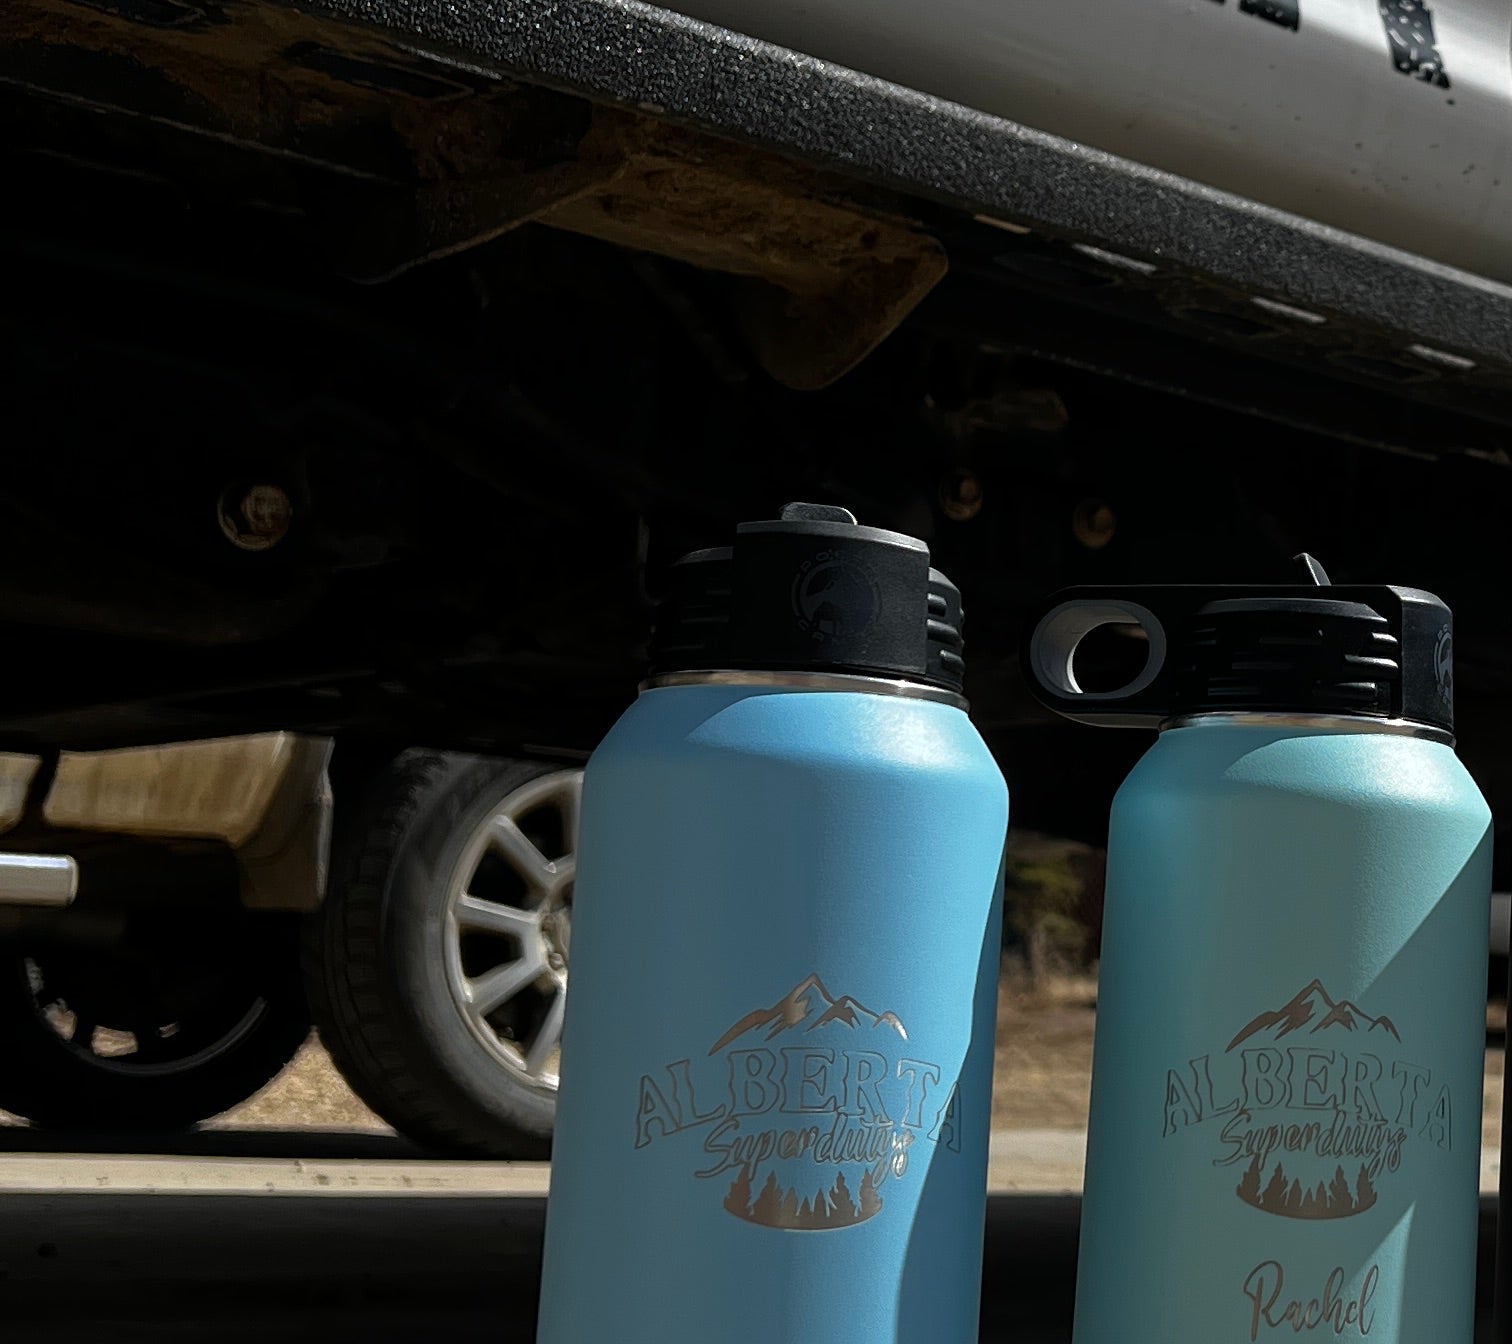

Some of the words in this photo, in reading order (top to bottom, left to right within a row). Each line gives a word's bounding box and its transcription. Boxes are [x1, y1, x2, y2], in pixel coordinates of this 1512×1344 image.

[633, 1046, 963, 1154] ALBERTA
[1162, 1046, 1453, 1153] ALBERTA
[1243, 1259, 1380, 1344] Rachel
